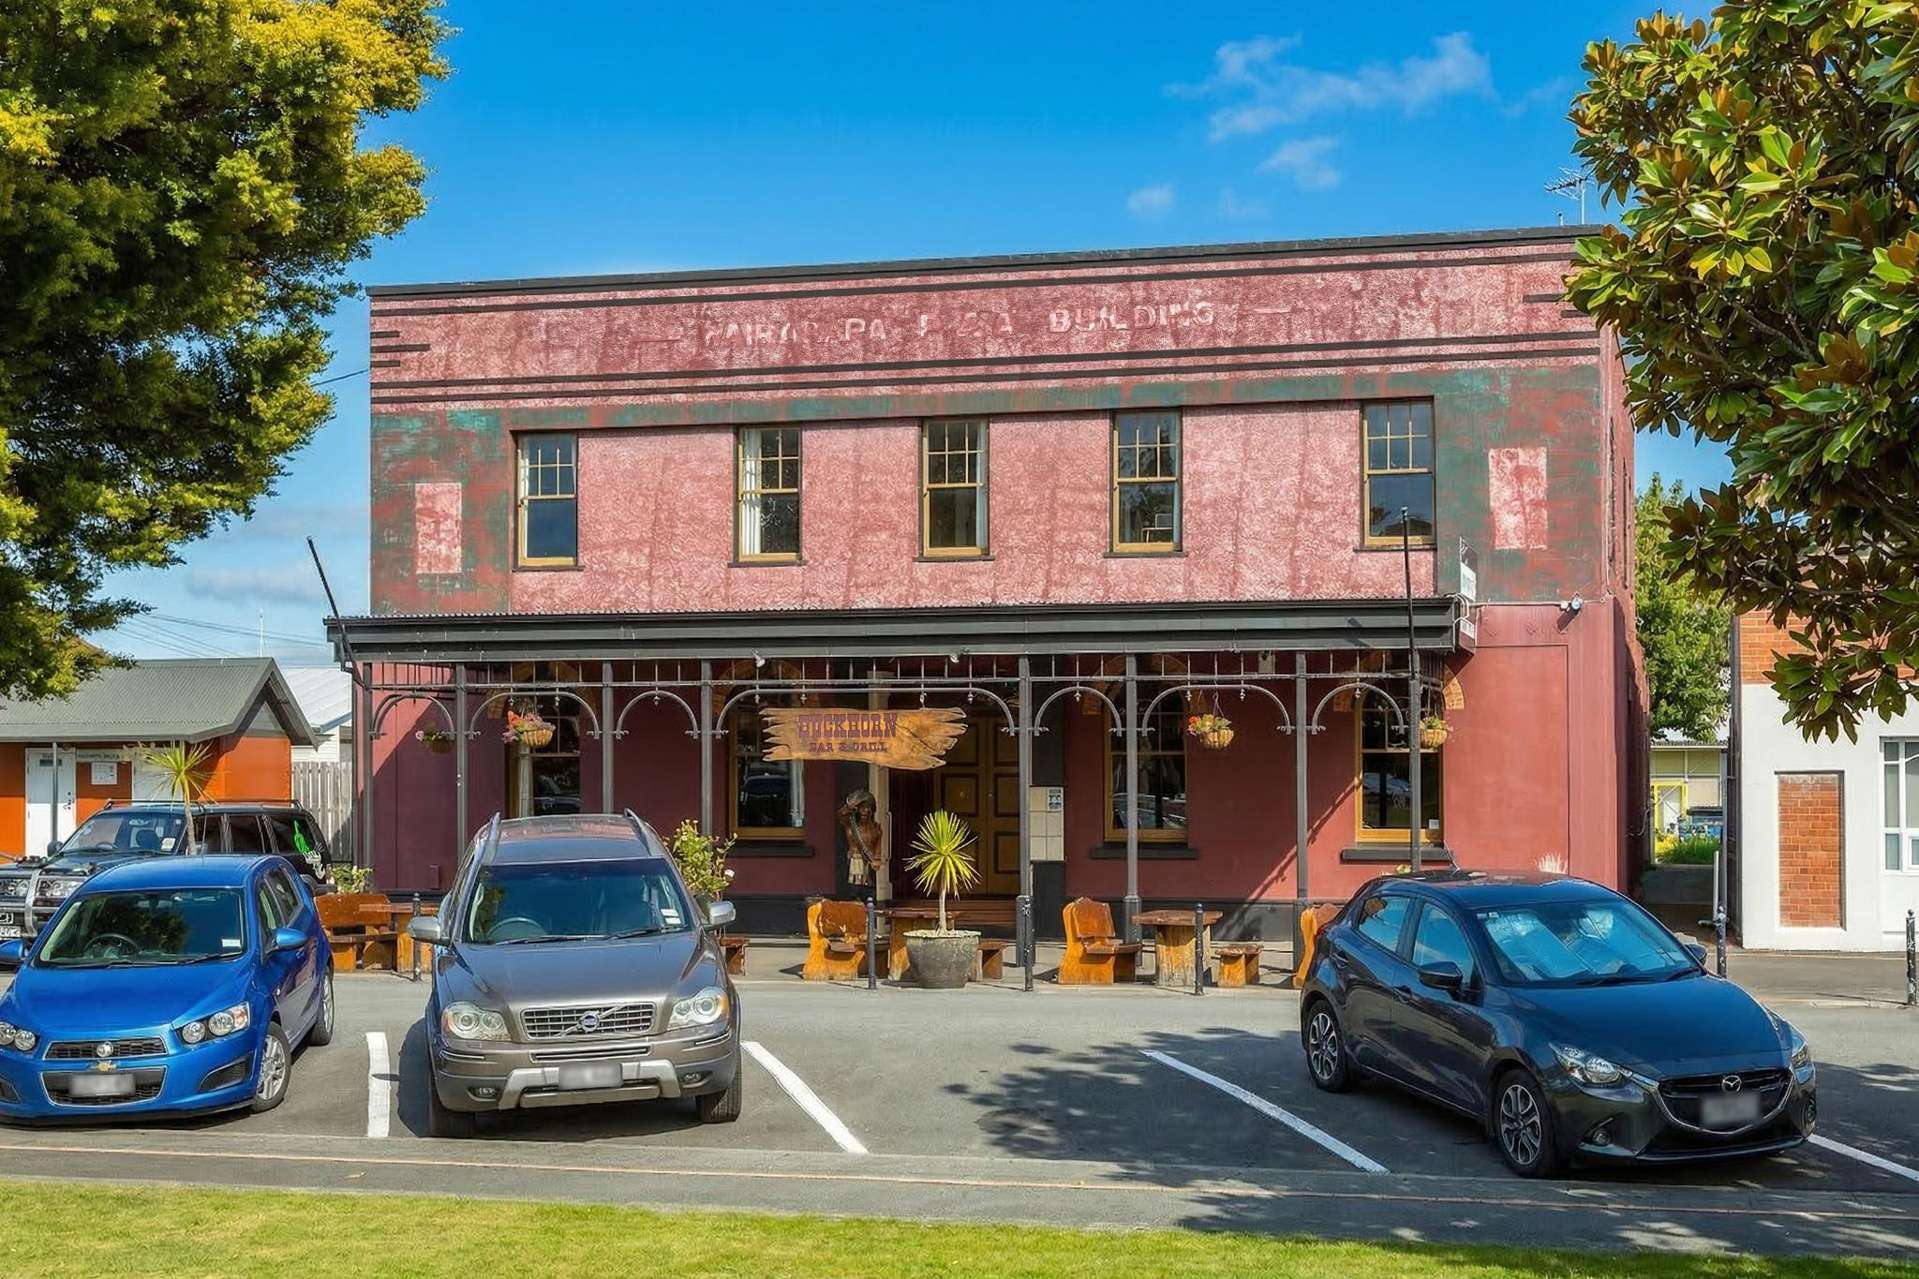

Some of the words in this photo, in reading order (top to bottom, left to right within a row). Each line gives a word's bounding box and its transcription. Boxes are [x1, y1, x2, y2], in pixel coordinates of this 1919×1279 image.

[798, 713, 897, 738] BUCKHORN
[809, 742, 834, 753] BAR
[853, 742, 888, 753] GRILL
